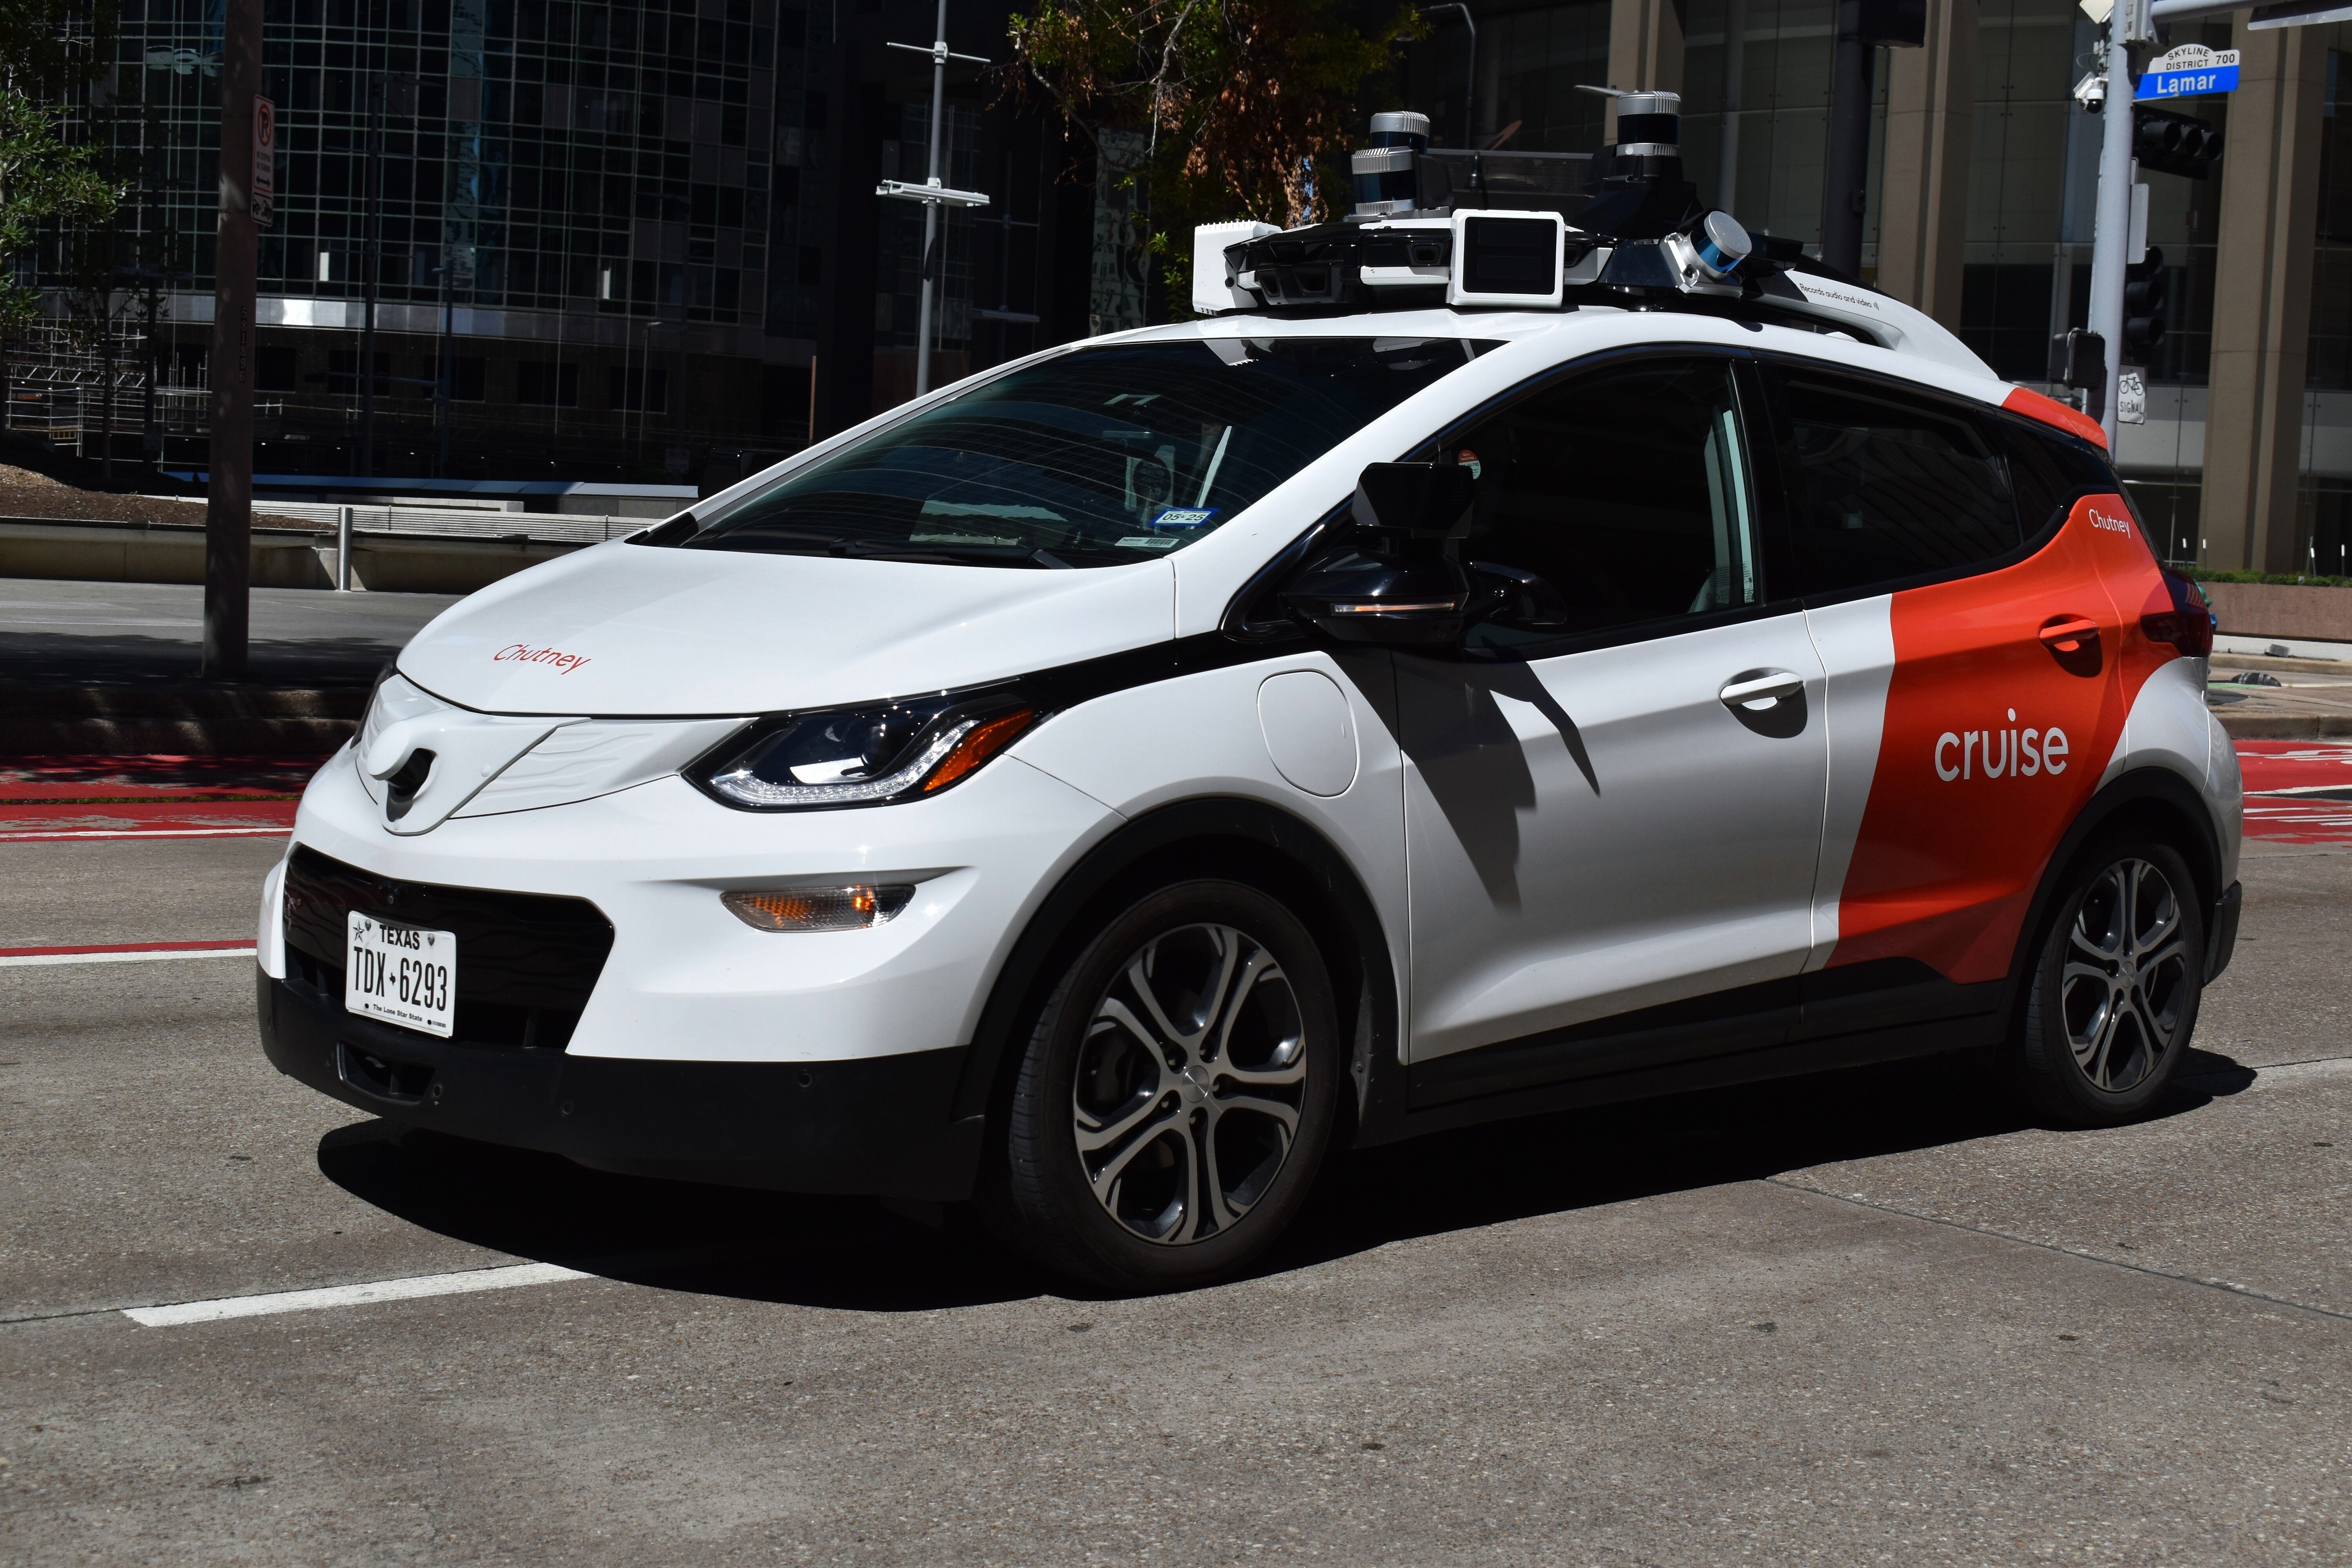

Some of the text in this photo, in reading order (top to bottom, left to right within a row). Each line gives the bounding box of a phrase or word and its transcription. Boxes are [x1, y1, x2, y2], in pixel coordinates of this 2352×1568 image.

[2166, 59, 2209, 71] DISTRICT
[2168, 47, 2210, 60] SKYLINE
[2216, 53, 2235, 64] 700
[2157, 74, 2216, 94] Lamar
[1799, 283, 1825, 296] Records
[1825, 291, 1843, 300] audio
[1855, 298, 1872, 308] video
[239, 306, 247, 382] 581896
[2120, 401, 2143, 414] SIGNAL
[2089, 508, 2131, 539] Chutney
[493, 644, 592, 675] Chutney
[1934, 708, 2069, 782] cruise
[379, 924, 420, 951] TEXAS
[353, 946, 448, 1012] TDX 6293
[383, 1006, 396, 1015] Lone
[397, 1010, 408, 1018] Star
[409, 1013, 423, 1022] State
